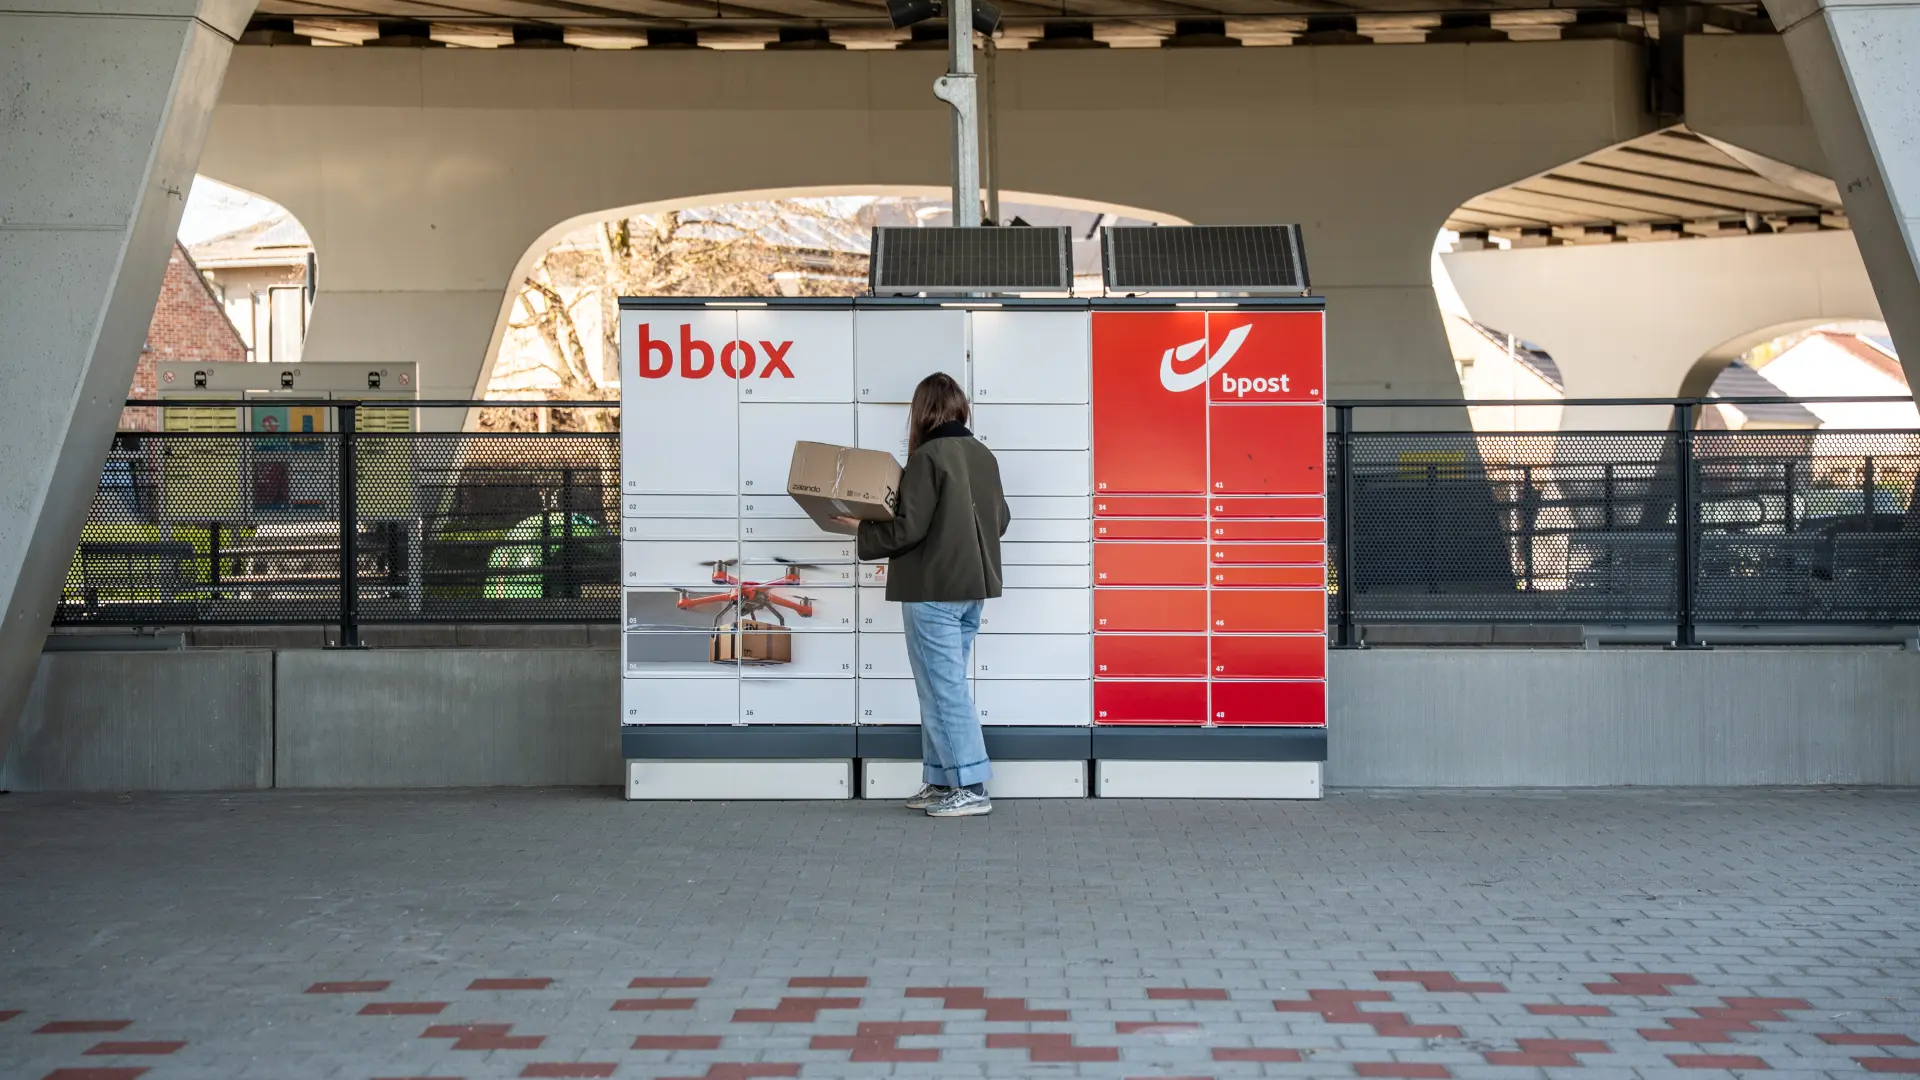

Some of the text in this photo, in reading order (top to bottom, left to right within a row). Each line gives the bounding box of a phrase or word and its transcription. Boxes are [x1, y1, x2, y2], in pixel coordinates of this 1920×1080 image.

[638, 322, 795, 379] bbox
[1222, 373, 1290, 397] bpost
[791, 483, 821, 493] zalando
